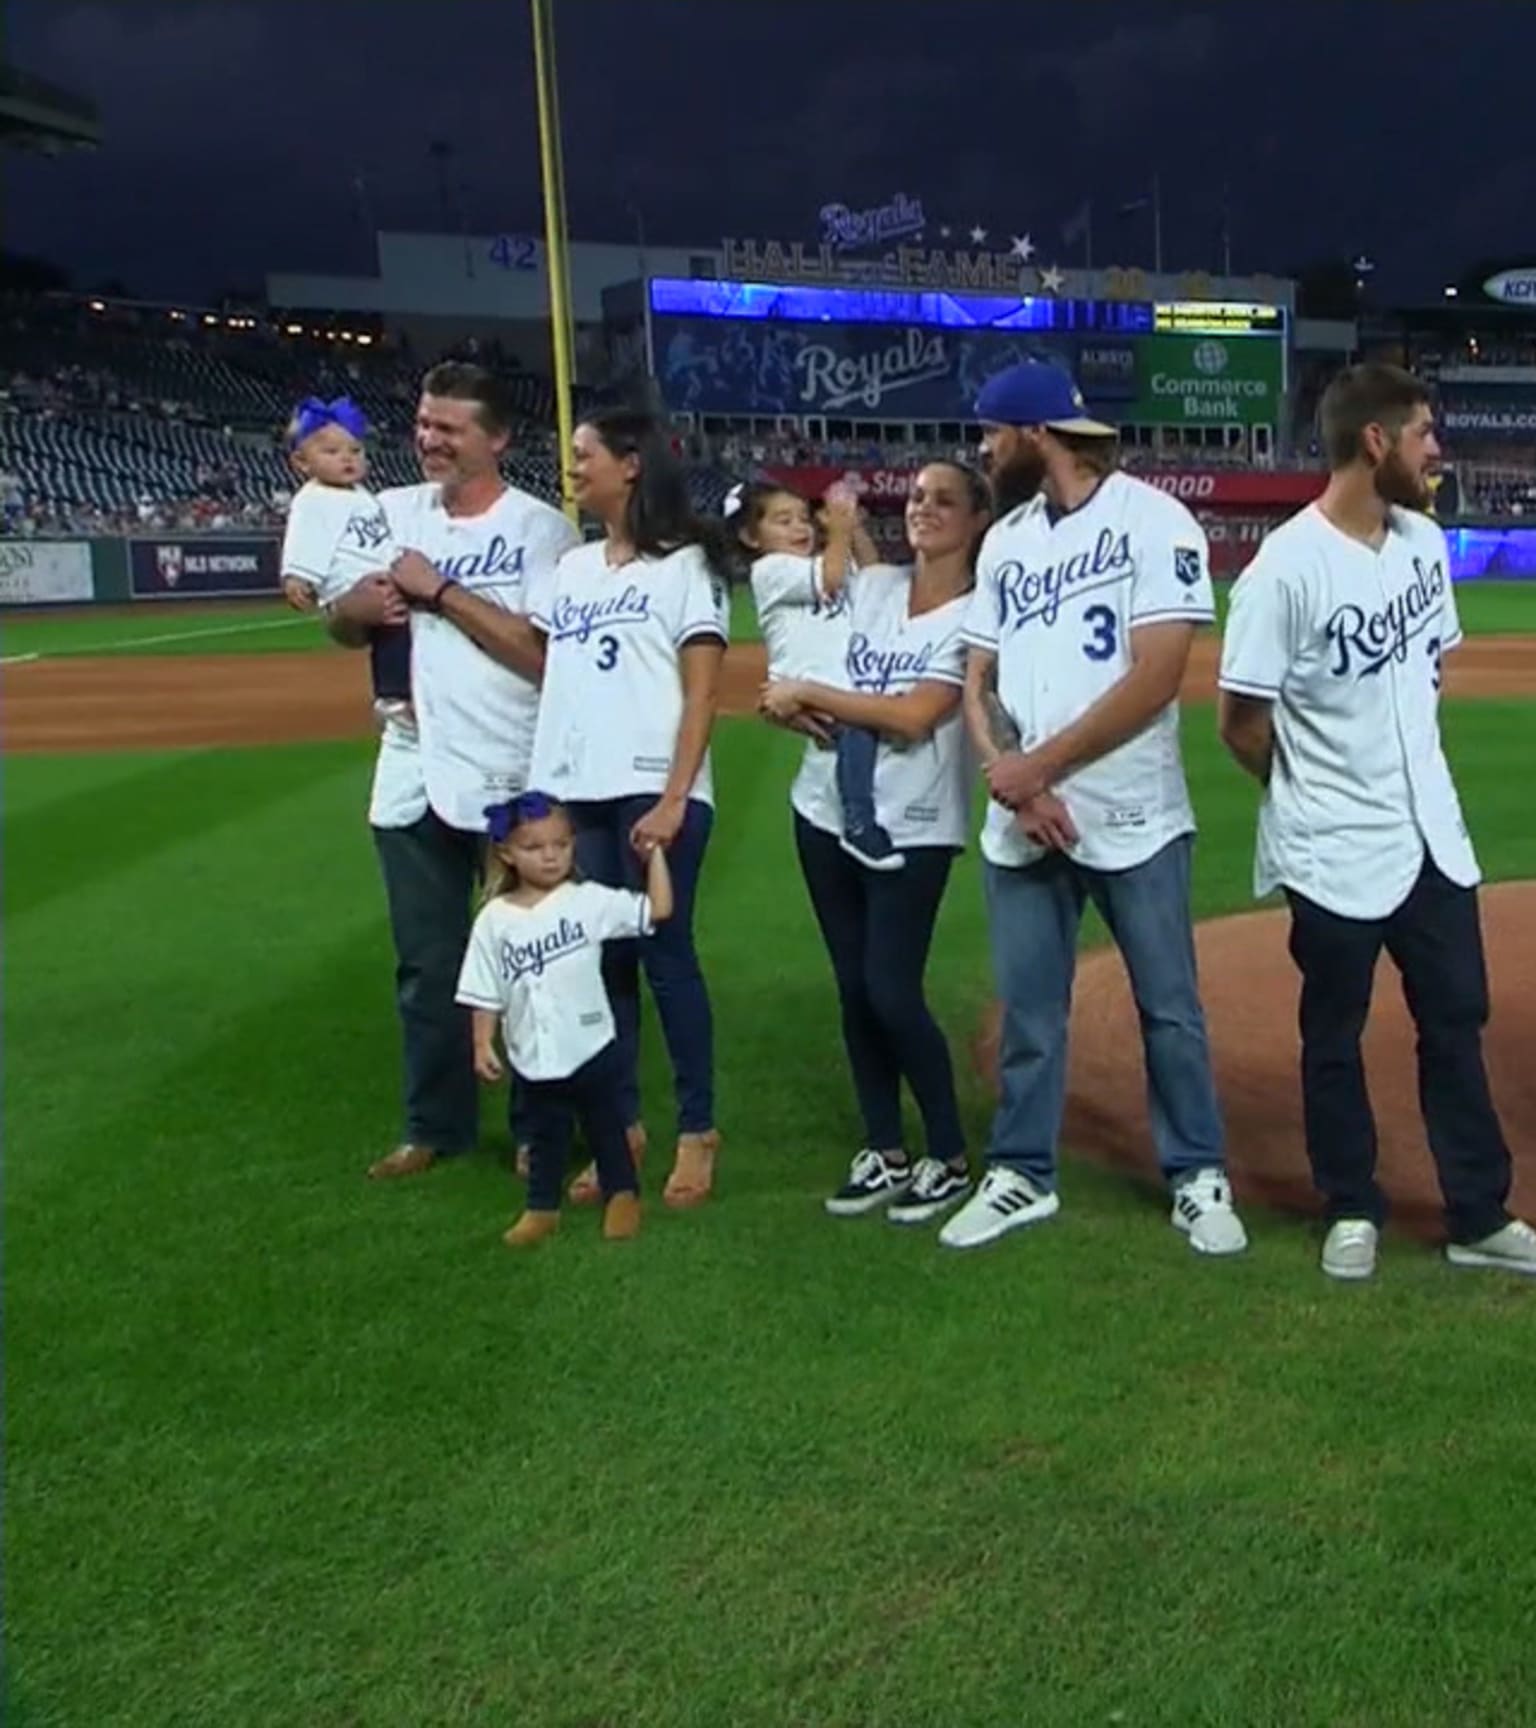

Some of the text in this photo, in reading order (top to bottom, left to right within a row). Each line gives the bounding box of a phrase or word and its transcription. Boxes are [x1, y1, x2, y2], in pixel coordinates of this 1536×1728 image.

[489, 239, 536, 271] 42
[797, 326, 952, 410] Royals
[1151, 372, 1268, 398] Commerce
[1183, 396, 1239, 419] Bank
[997, 528, 1137, 630] Royals
[1082, 604, 1117, 662] 3
[1325, 556, 1445, 680] Royals
[597, 635, 620, 671] 3
[500, 917, 588, 982] Royals
